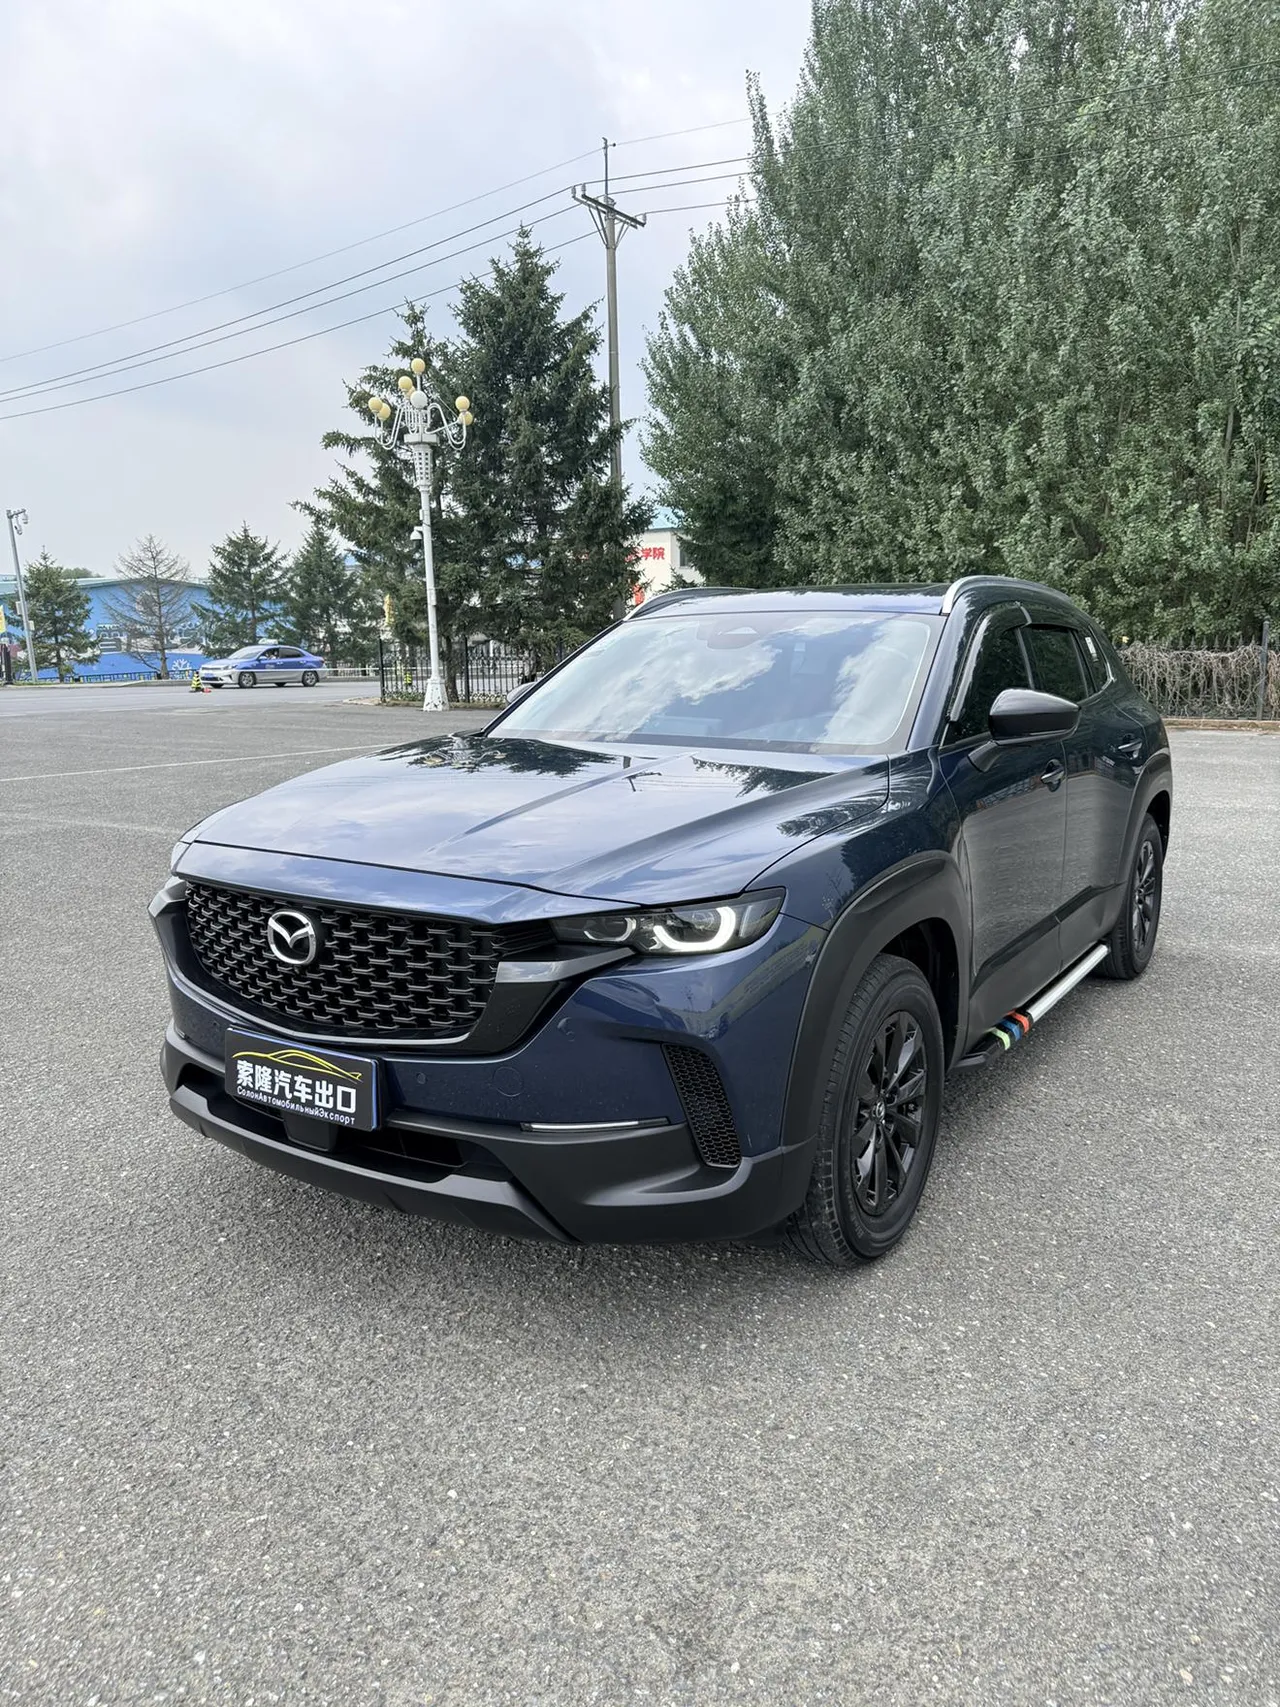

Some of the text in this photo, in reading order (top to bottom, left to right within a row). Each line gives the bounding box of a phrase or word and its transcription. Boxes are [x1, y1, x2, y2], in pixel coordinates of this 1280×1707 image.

[236, 1059, 356, 1114] 索隆汽车出口
